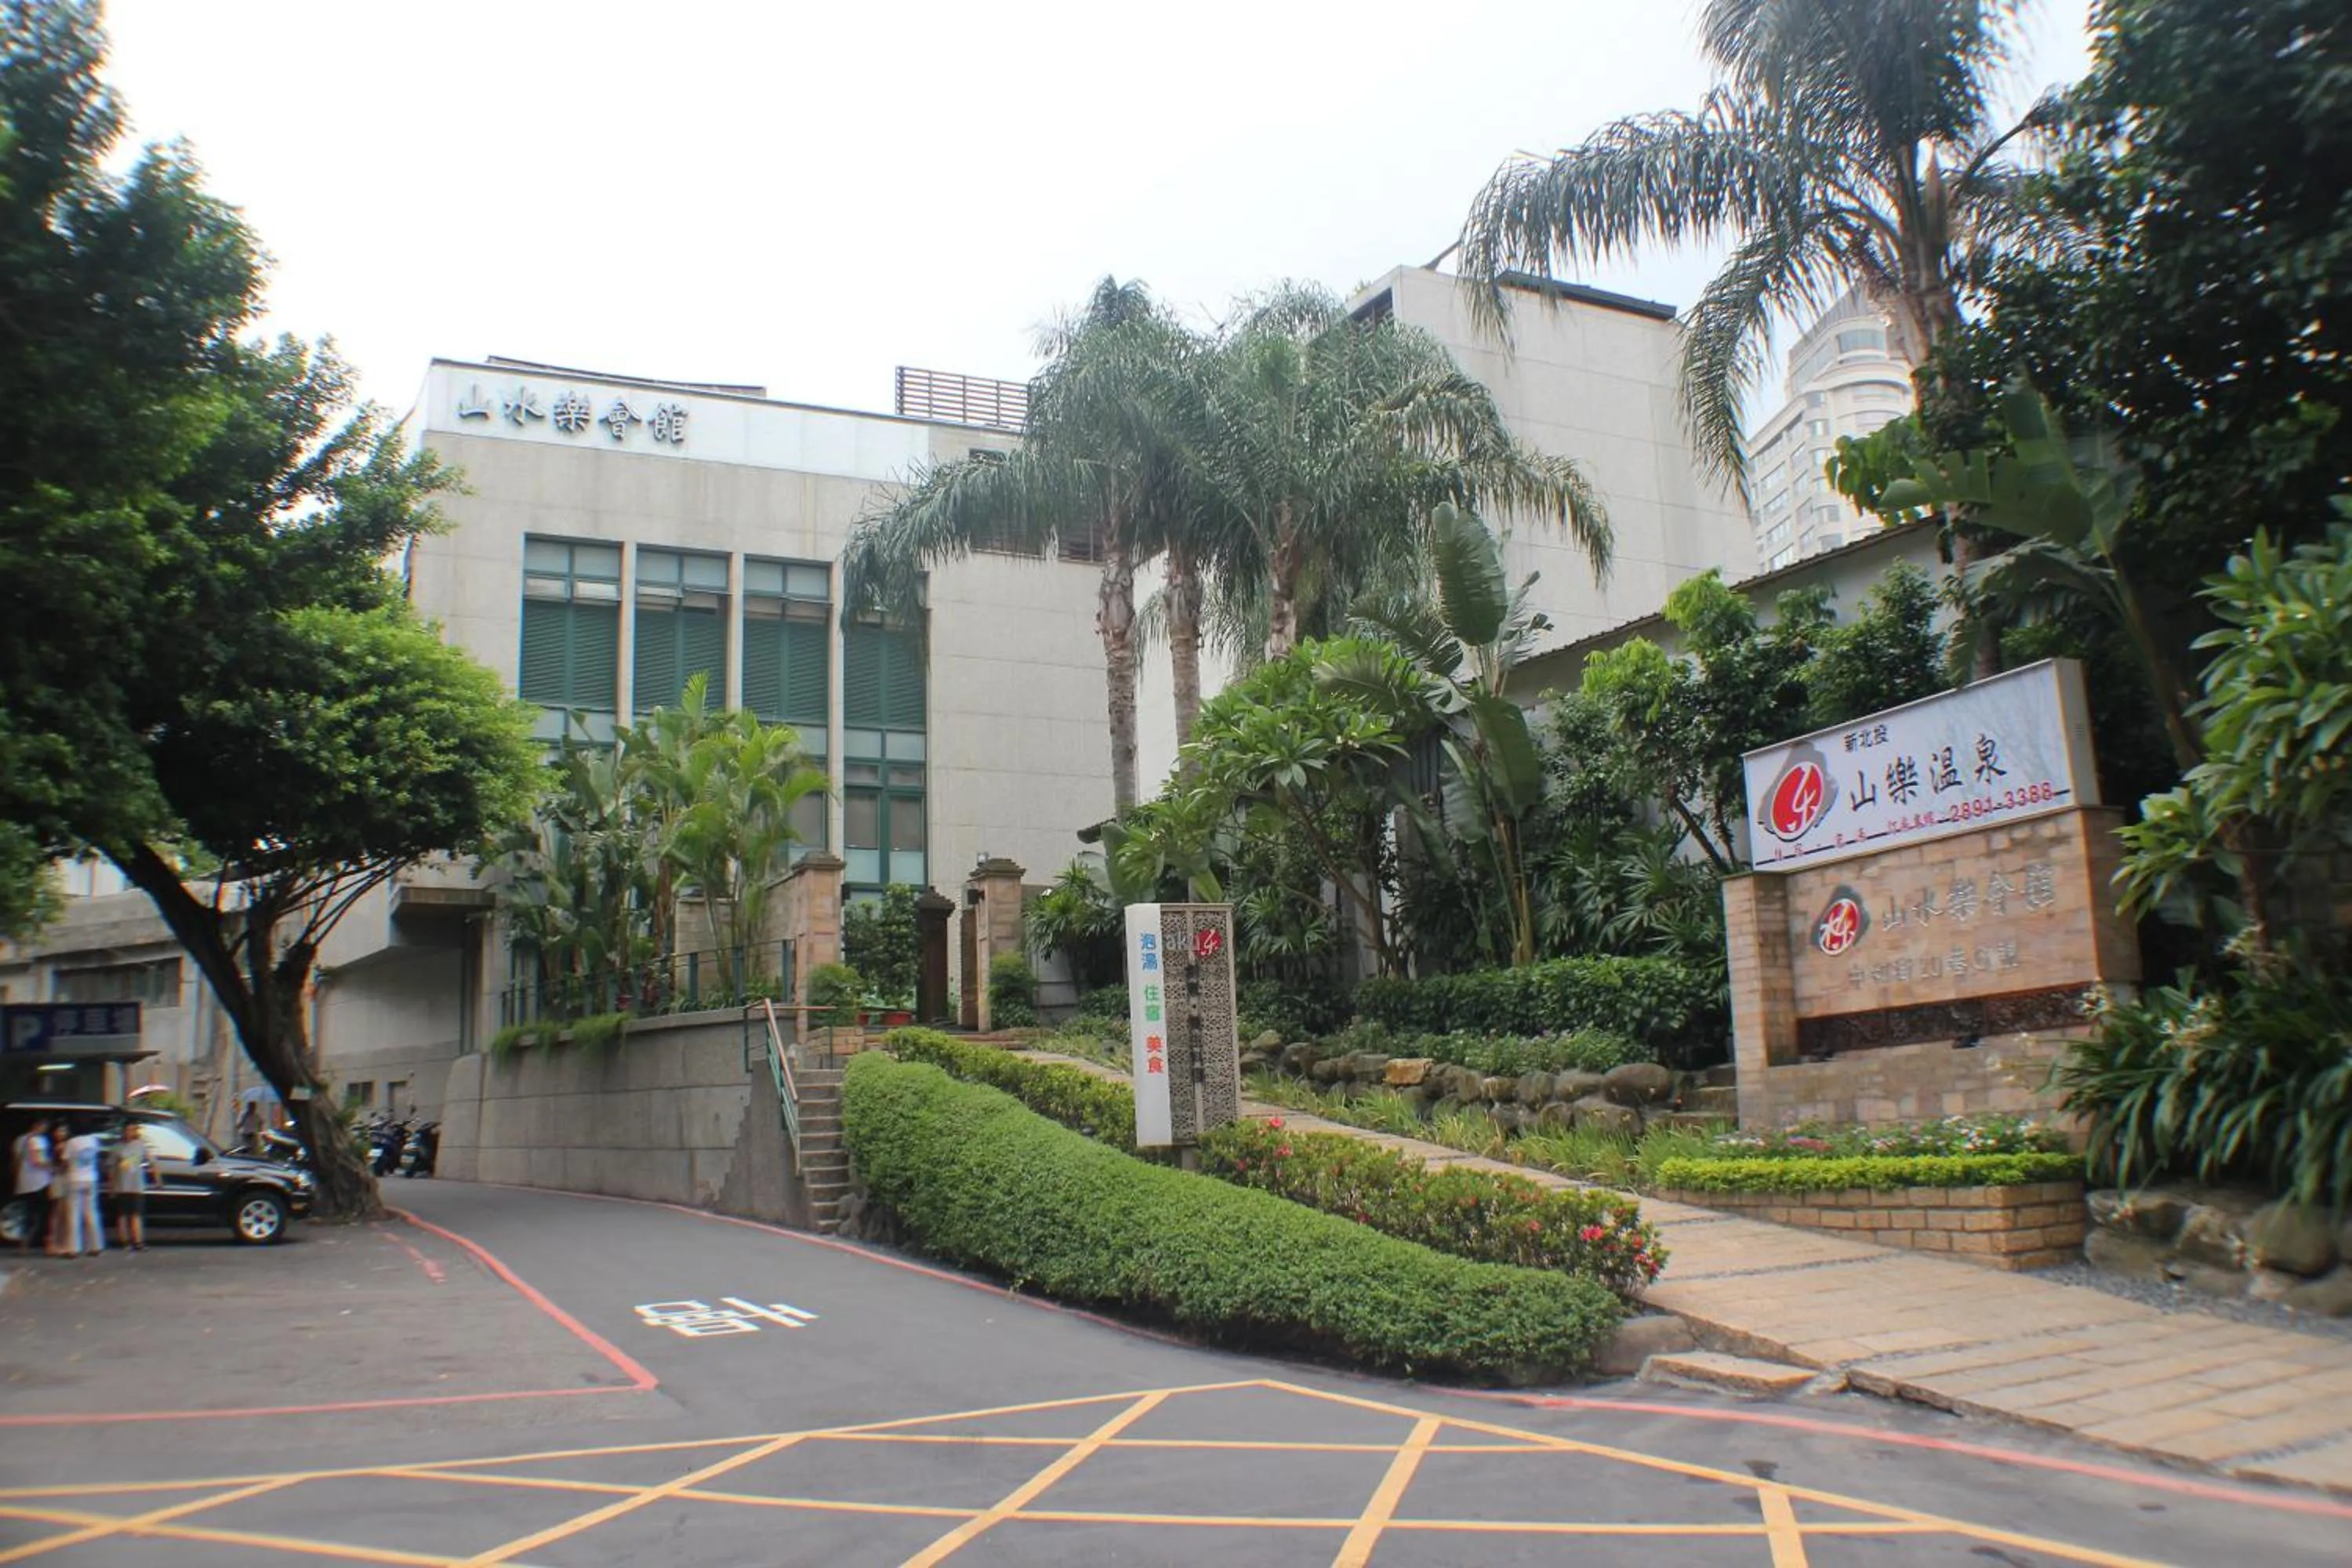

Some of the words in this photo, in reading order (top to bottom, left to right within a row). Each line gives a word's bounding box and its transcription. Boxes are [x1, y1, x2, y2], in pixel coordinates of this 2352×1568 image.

[459, 383, 688, 444] 山水樂會館
[1843, 725, 1889, 753] 新北投
[1950, 782, 2055, 822] 2891-3388
[1140, 932, 1159, 971] 泡湯
[10, 1014, 42, 1048] P
[1146, 1034, 1165, 1073] 美食
[633, 1296, 820, 1338] 慢
